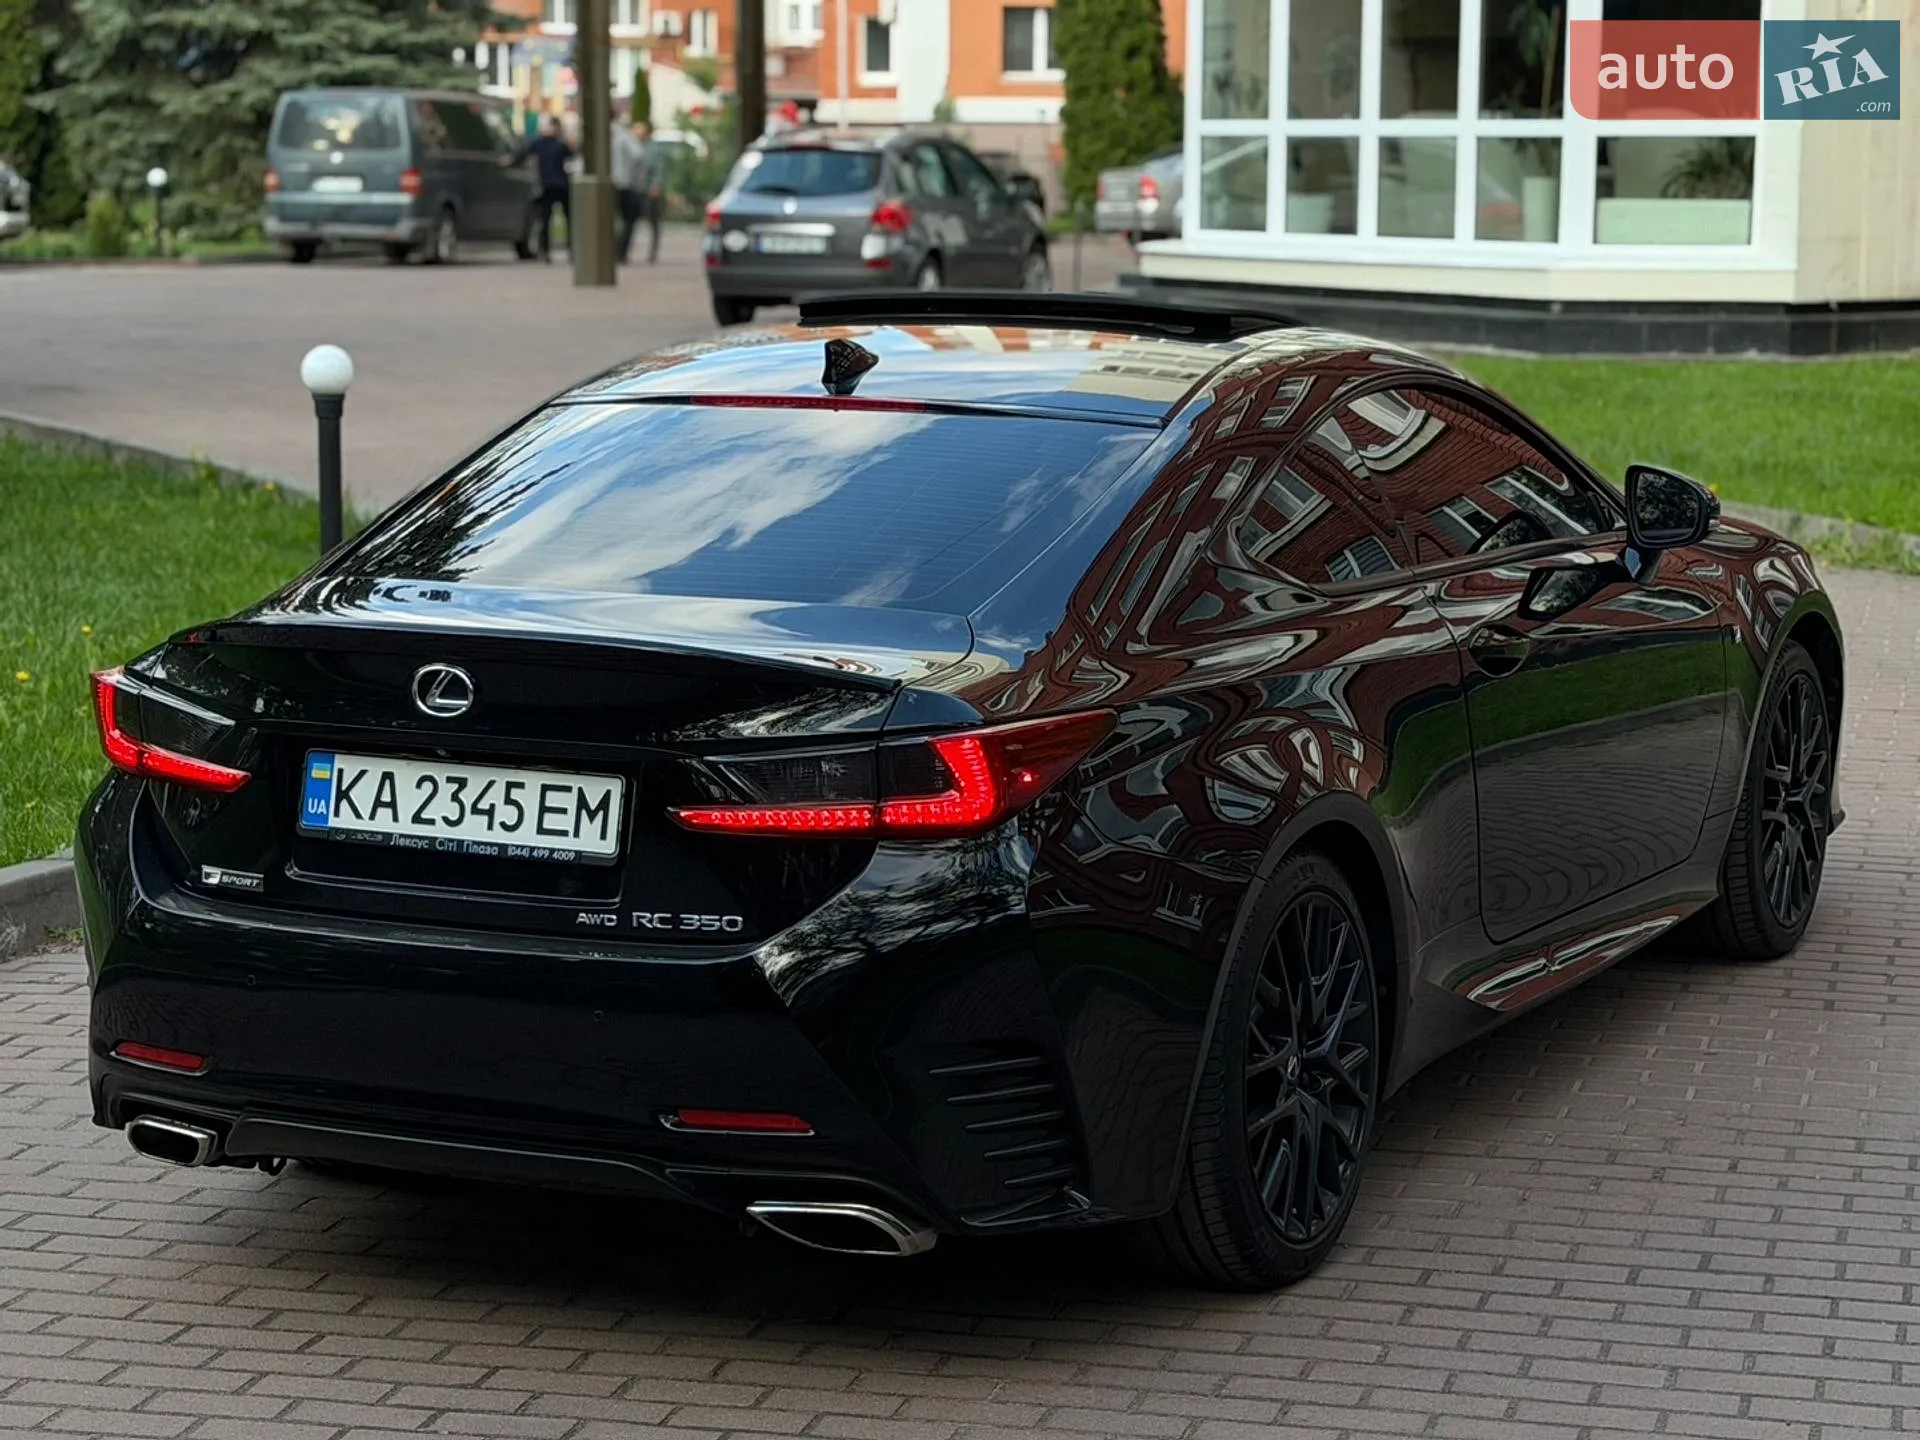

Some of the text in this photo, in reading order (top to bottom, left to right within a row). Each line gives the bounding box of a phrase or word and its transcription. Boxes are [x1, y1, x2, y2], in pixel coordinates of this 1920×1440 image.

[307, 797, 328, 815] UA
[411, 774, 526, 833] 2345
[536, 783, 613, 841] EM
[221, 874, 260, 887] SPORT
[576, 912, 618, 927] AWD
[632, 911, 744, 932] RC 350
